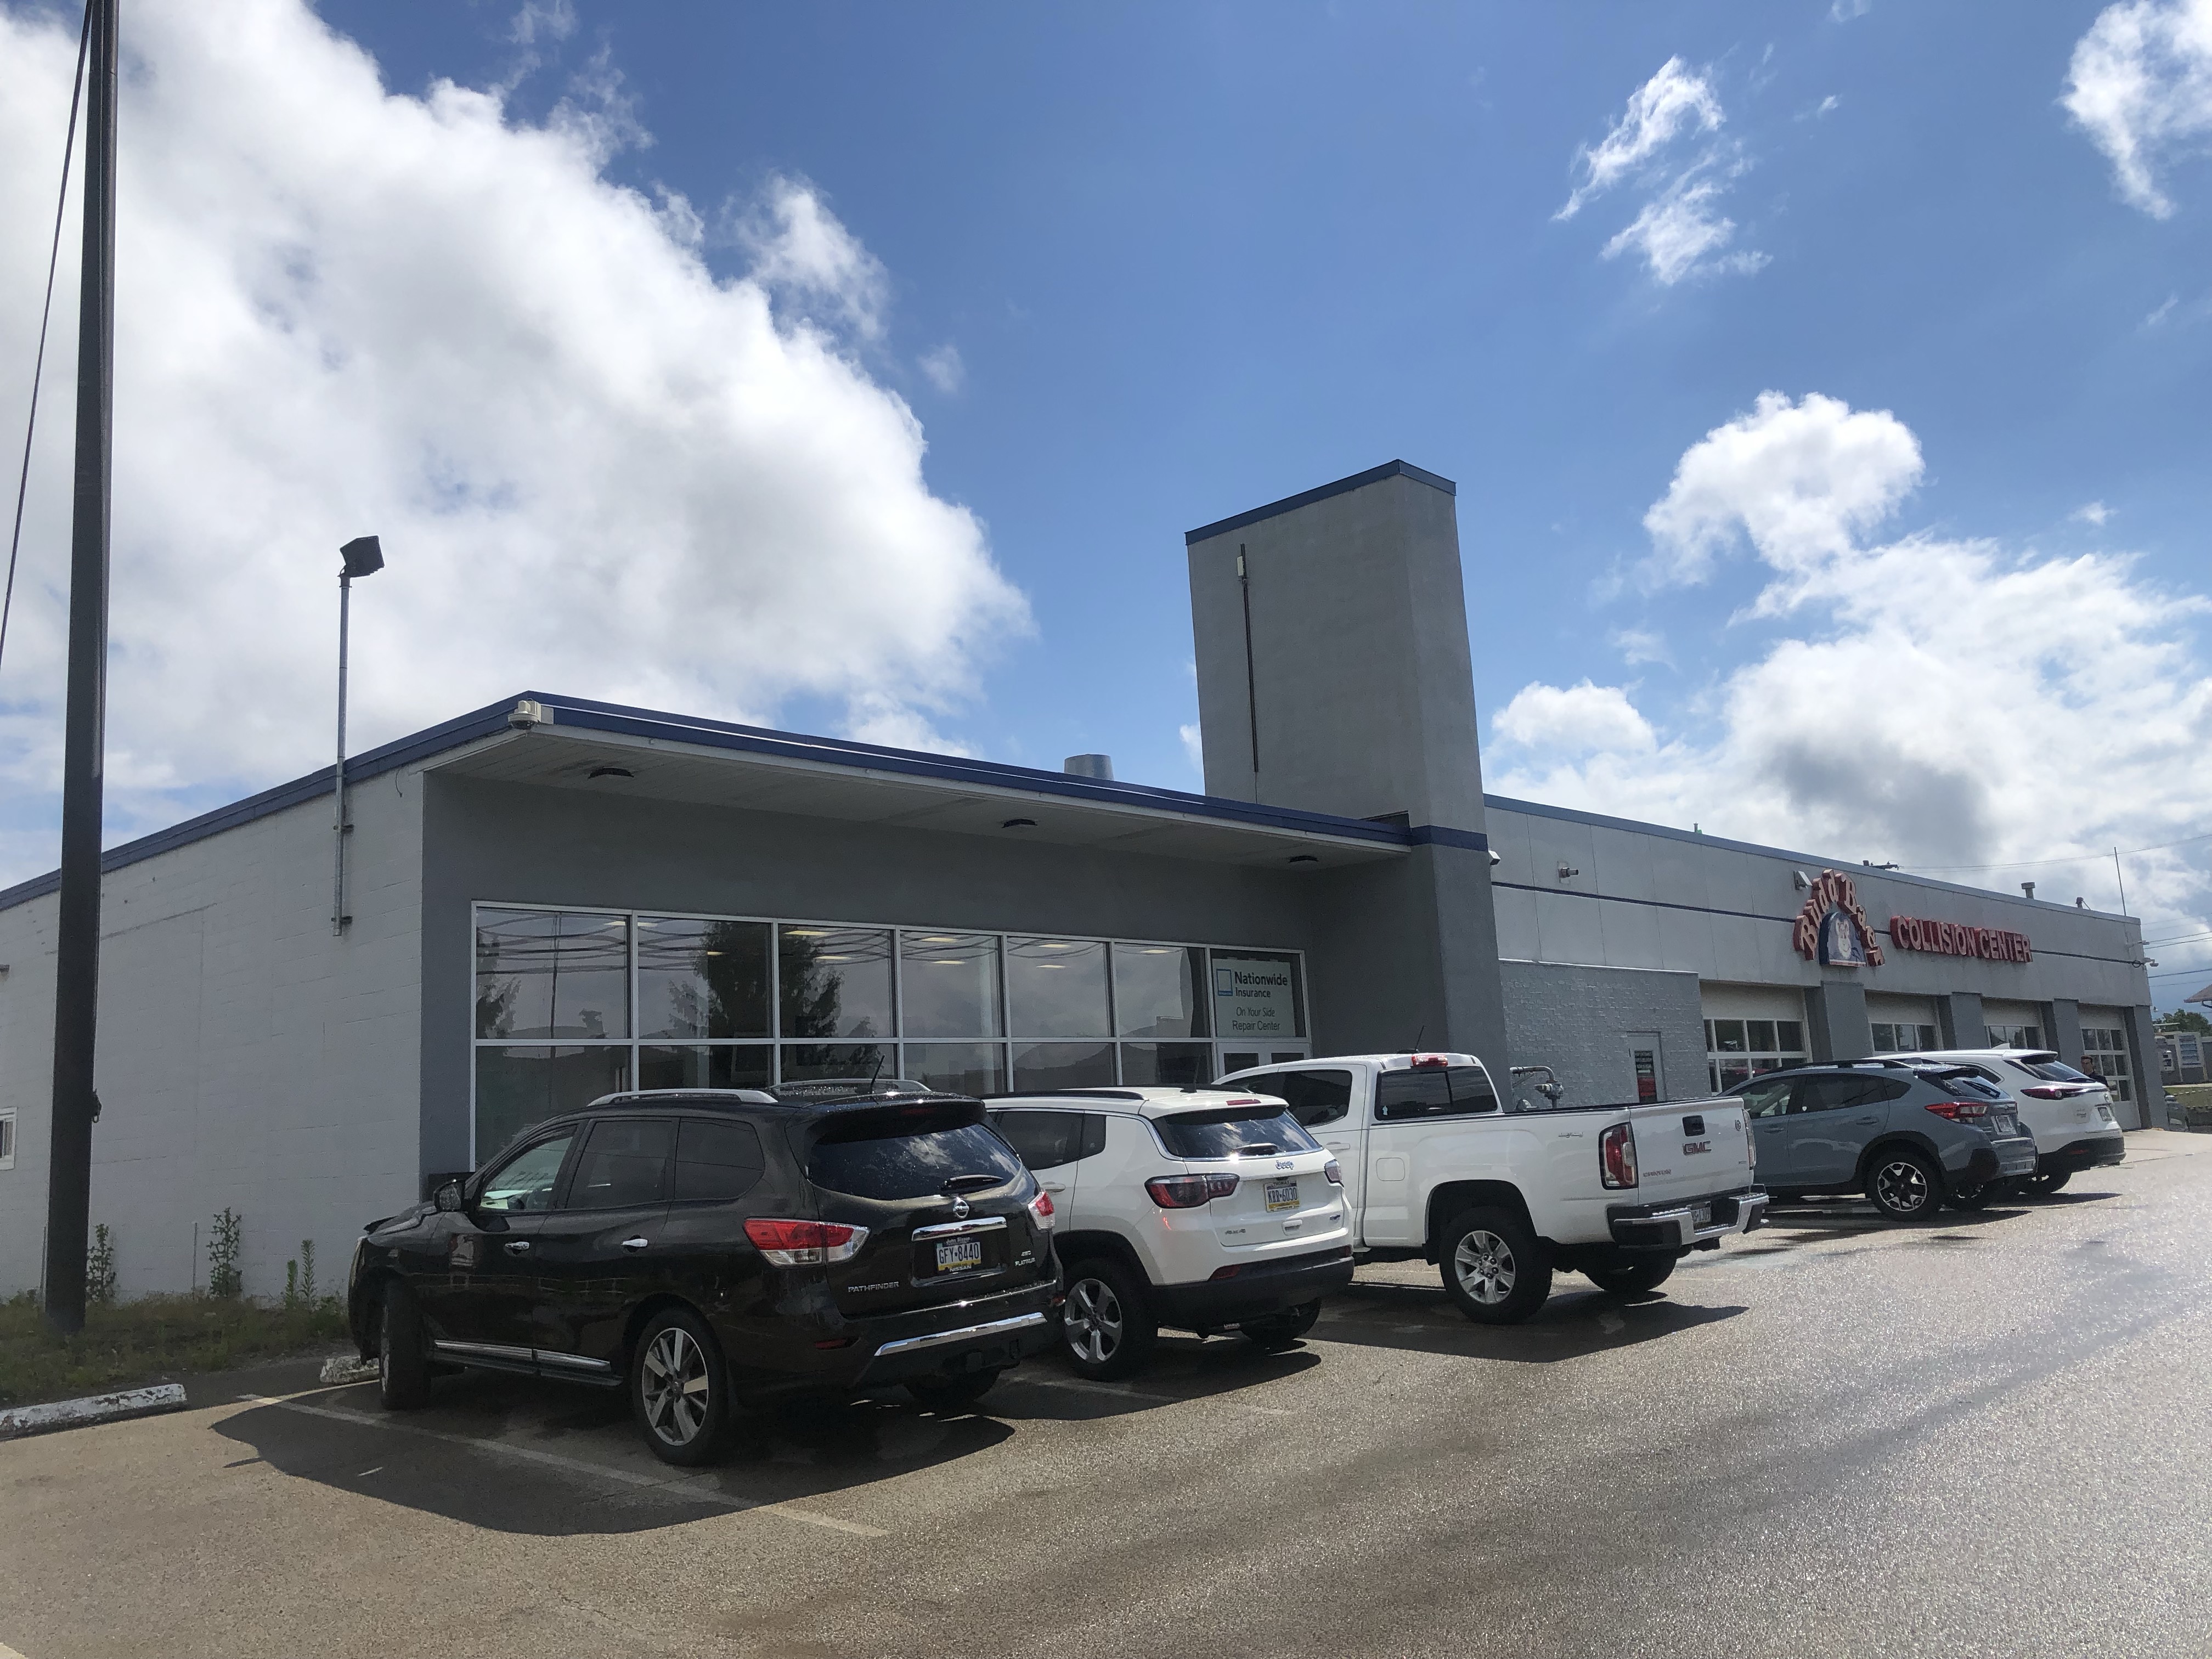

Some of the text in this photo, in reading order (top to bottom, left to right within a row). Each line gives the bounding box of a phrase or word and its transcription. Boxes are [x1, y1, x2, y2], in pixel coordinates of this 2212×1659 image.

[1794, 869, 1885, 967] Budd Baer
[1892, 915, 2033, 963] COLLISION CENTER
[1234, 971, 1288, 986] Nationwide
[1235, 987, 1271, 998] Insurance
[1236, 1007, 1276, 1017] On Your Side
[1232, 1020, 1280, 1032] Repair Center
[1683, 1141, 1712, 1155] GMC
[1274, 1160, 1295, 1170] Jeep
[848, 1282, 900, 1293] PATHFINDER
